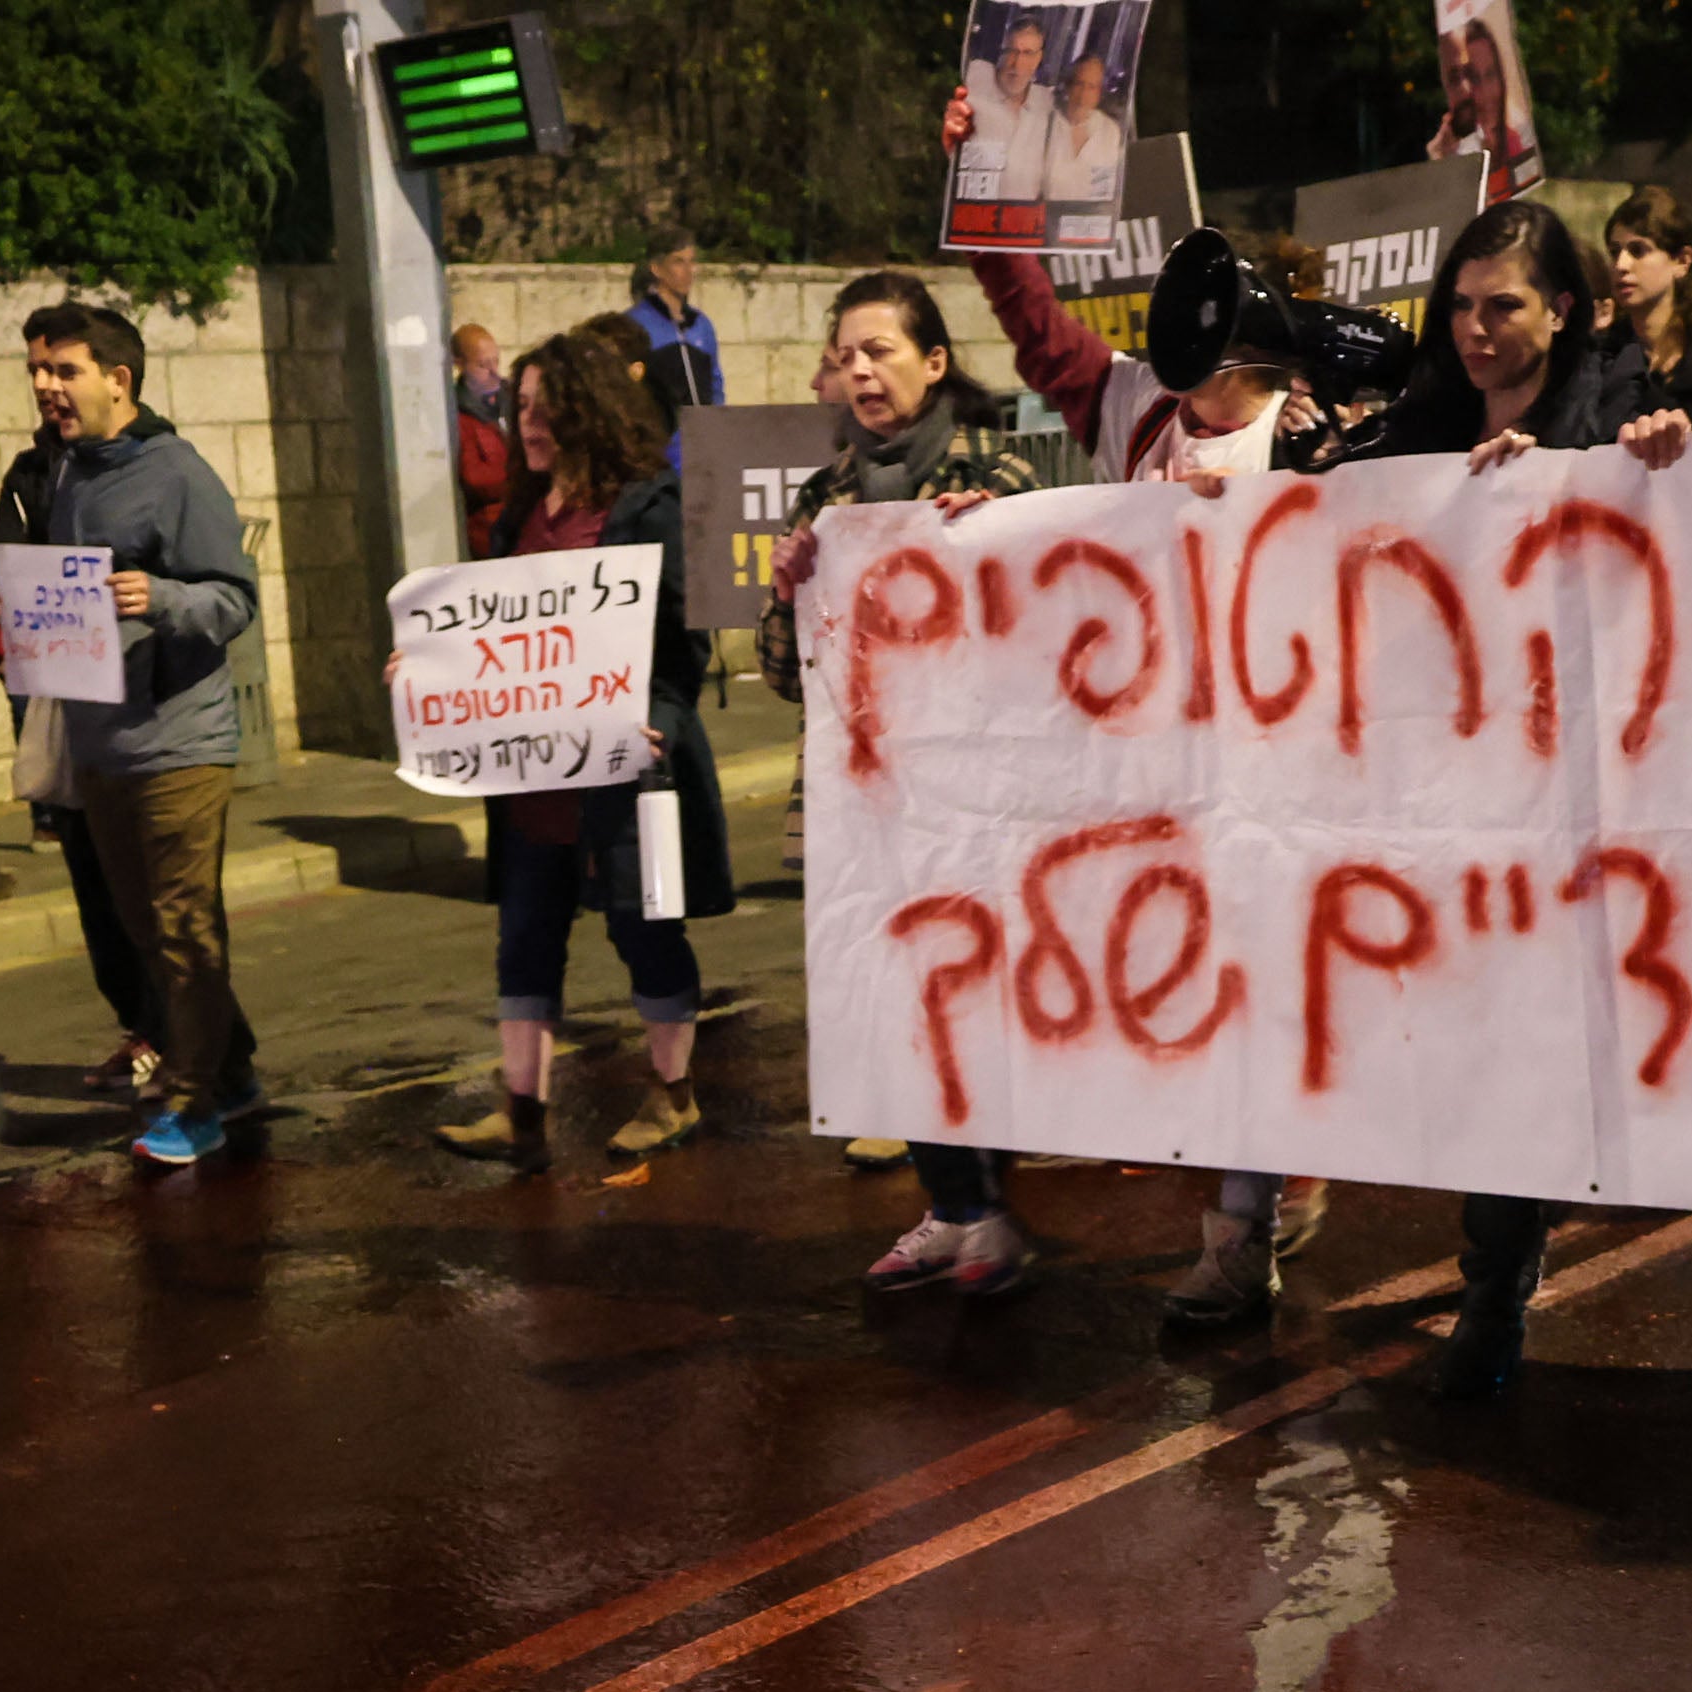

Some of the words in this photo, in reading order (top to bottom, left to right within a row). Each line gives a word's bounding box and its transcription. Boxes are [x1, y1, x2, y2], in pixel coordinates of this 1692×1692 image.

[1323, 226, 1439, 305] עסקה
[63, 556, 101, 577] דם
[591, 560, 641, 612] כל
[410, 590, 527, 633] שעובר
[538, 583, 577, 617] יום
[473, 625, 577, 680] הורג
[842, 475, 1679, 787] החטופים
[404, 679, 563, 739] החטופים!
[576, 663, 632, 710] את
[490, 729, 592, 780] עיסקה
[886, 811, 1250, 1129] שלך
